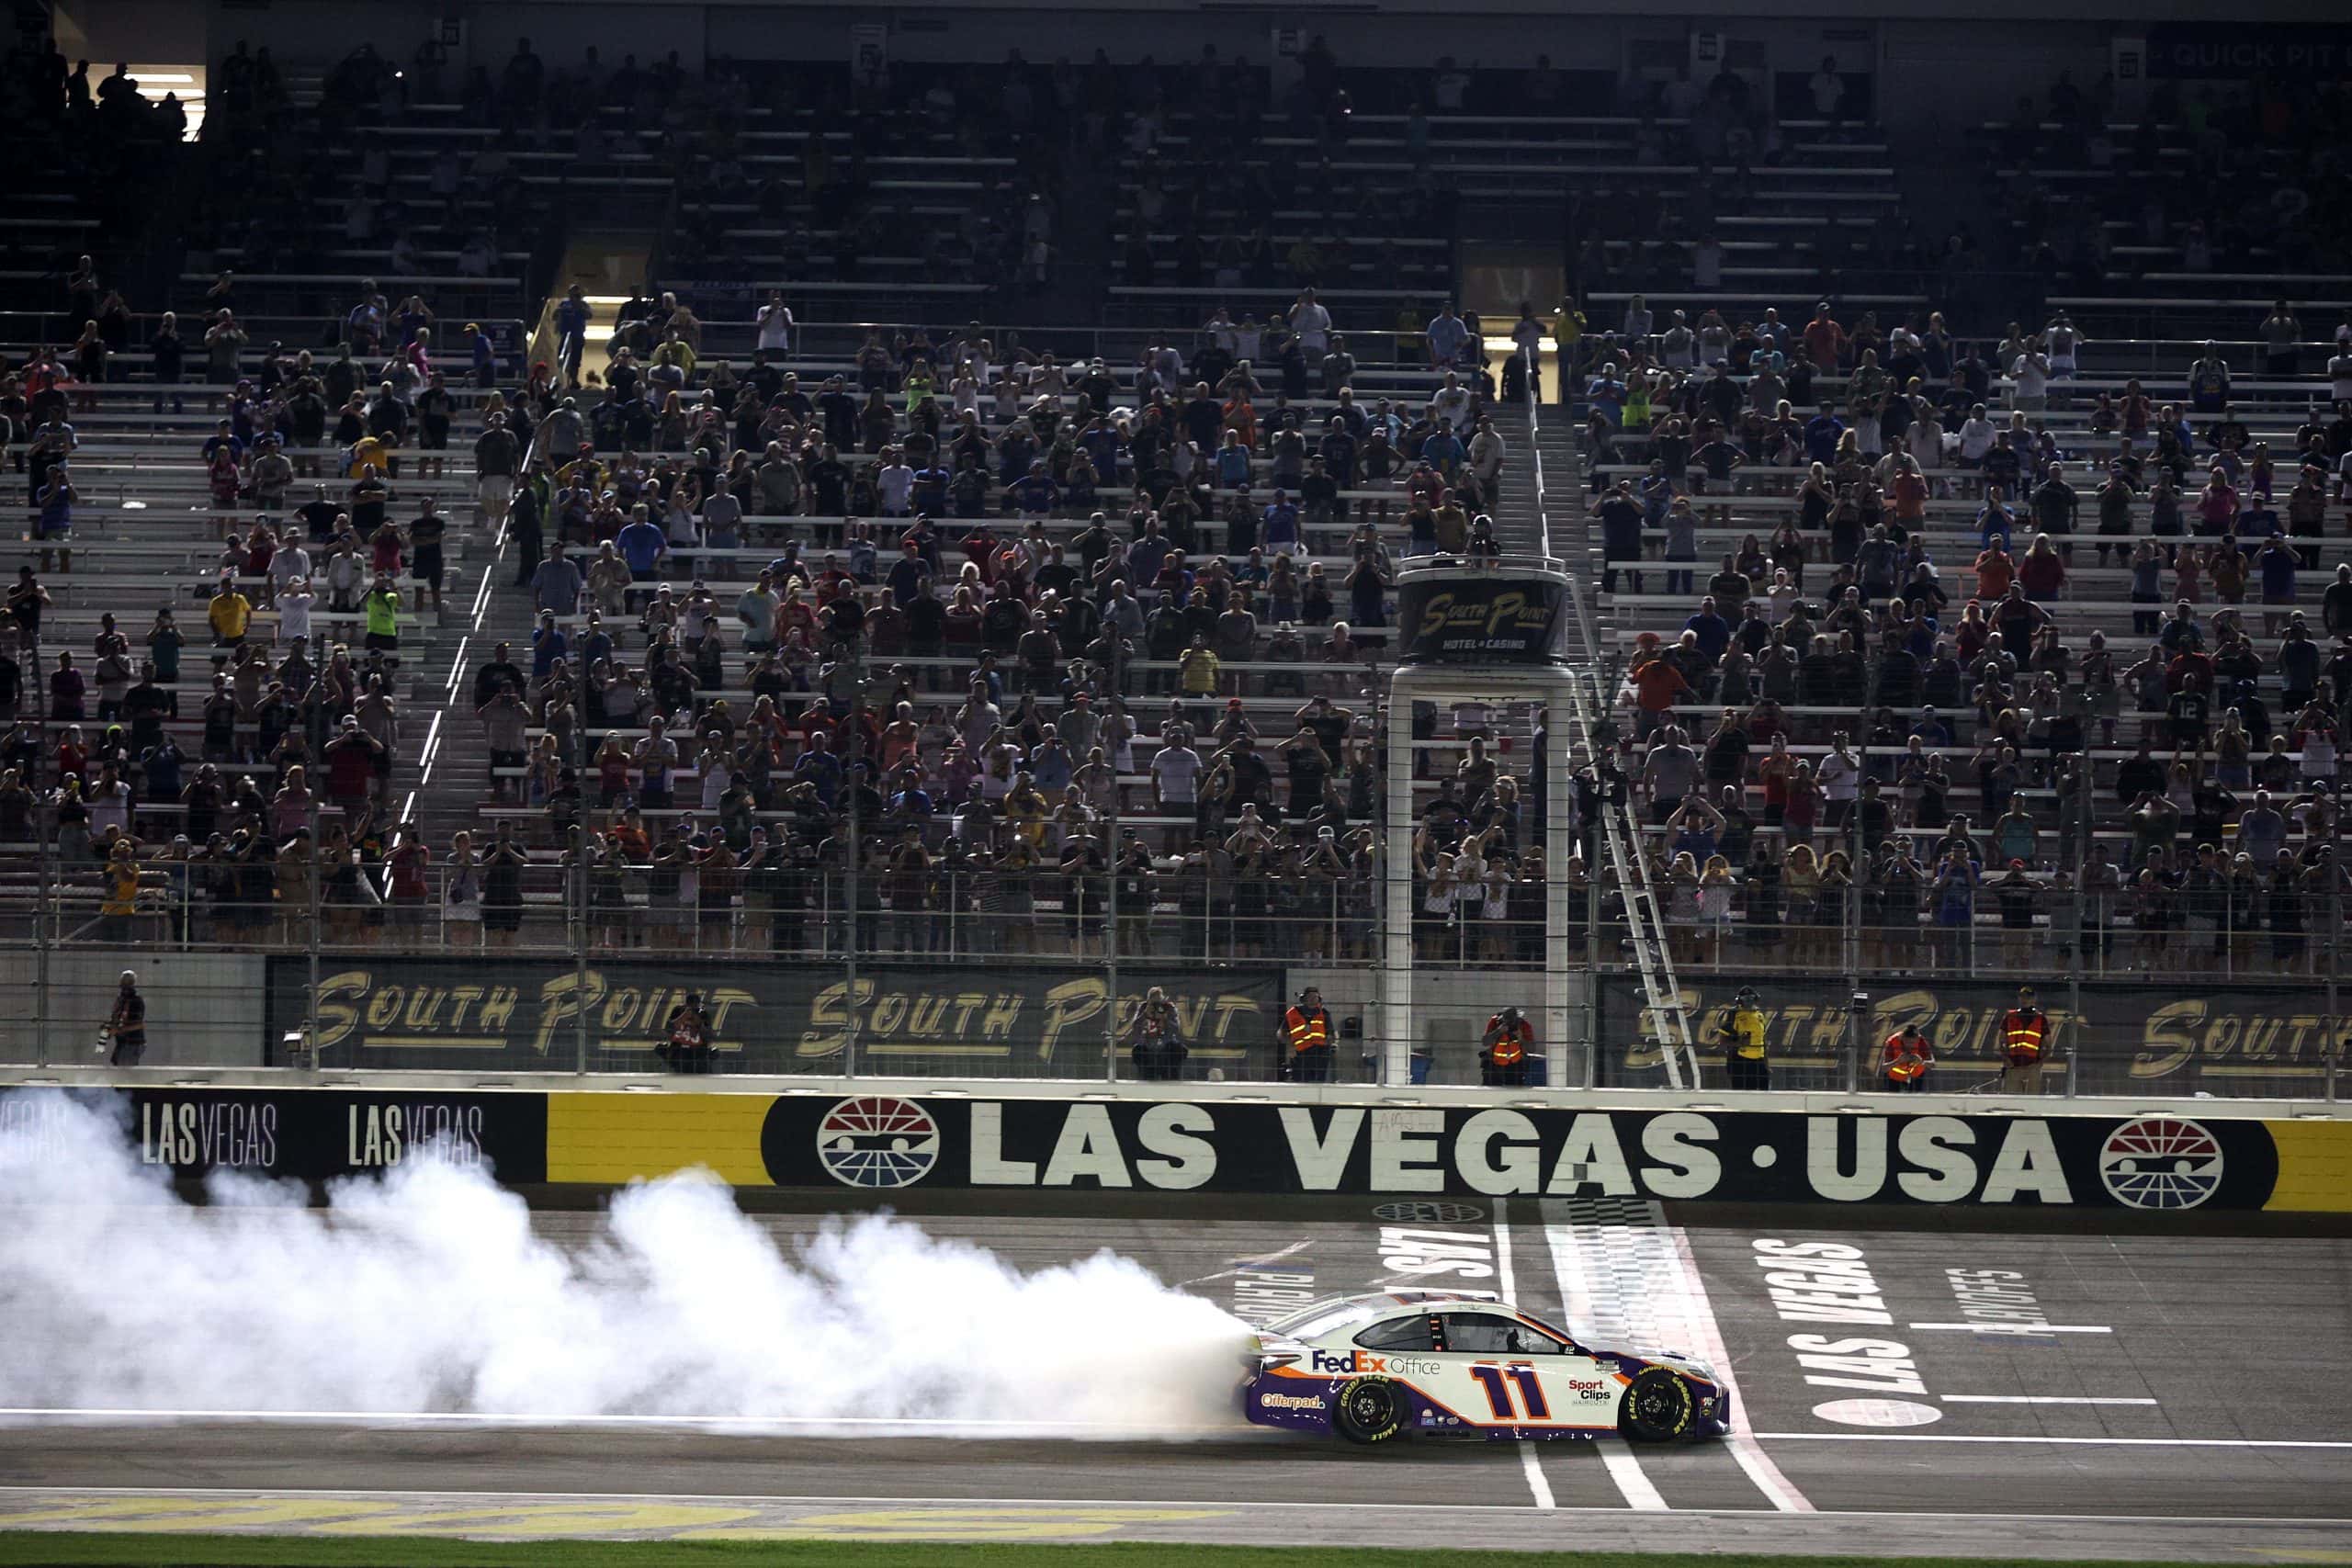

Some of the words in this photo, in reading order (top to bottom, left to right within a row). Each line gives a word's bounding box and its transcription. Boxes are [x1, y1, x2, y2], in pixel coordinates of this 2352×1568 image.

[1419, 593, 1488, 635] SOUTH
[1487, 592, 1551, 637] POINT
[1442, 639, 1477, 650] HOTEL
[1486, 639, 1526, 650] CASINO
[301, 970, 519, 1052] SOUTH
[795, 977, 1026, 1057] SOUTH
[1037, 976, 1262, 1066] PONT
[1623, 989, 1849, 1069] SOTH
[1864, 989, 2090, 1078] POIT
[969, 1102, 1216, 1190] LAS
[1278, 1108, 1722, 1199] VEGAS
[1807, 1116, 2074, 1204] USA
[1234, 1272, 1315, 1319] PLAYO
[1312, 1350, 1386, 1373] FedEx
[1390, 1358, 1441, 1375] Office
[1469, 1359, 1552, 1421] 11
[1569, 1380, 1603, 1392] Sport
[1580, 1389, 1611, 1402] Clips
[1627, 1389, 1642, 1420] EAGLE
[1371, 1422, 1397, 1441] EAGLE
